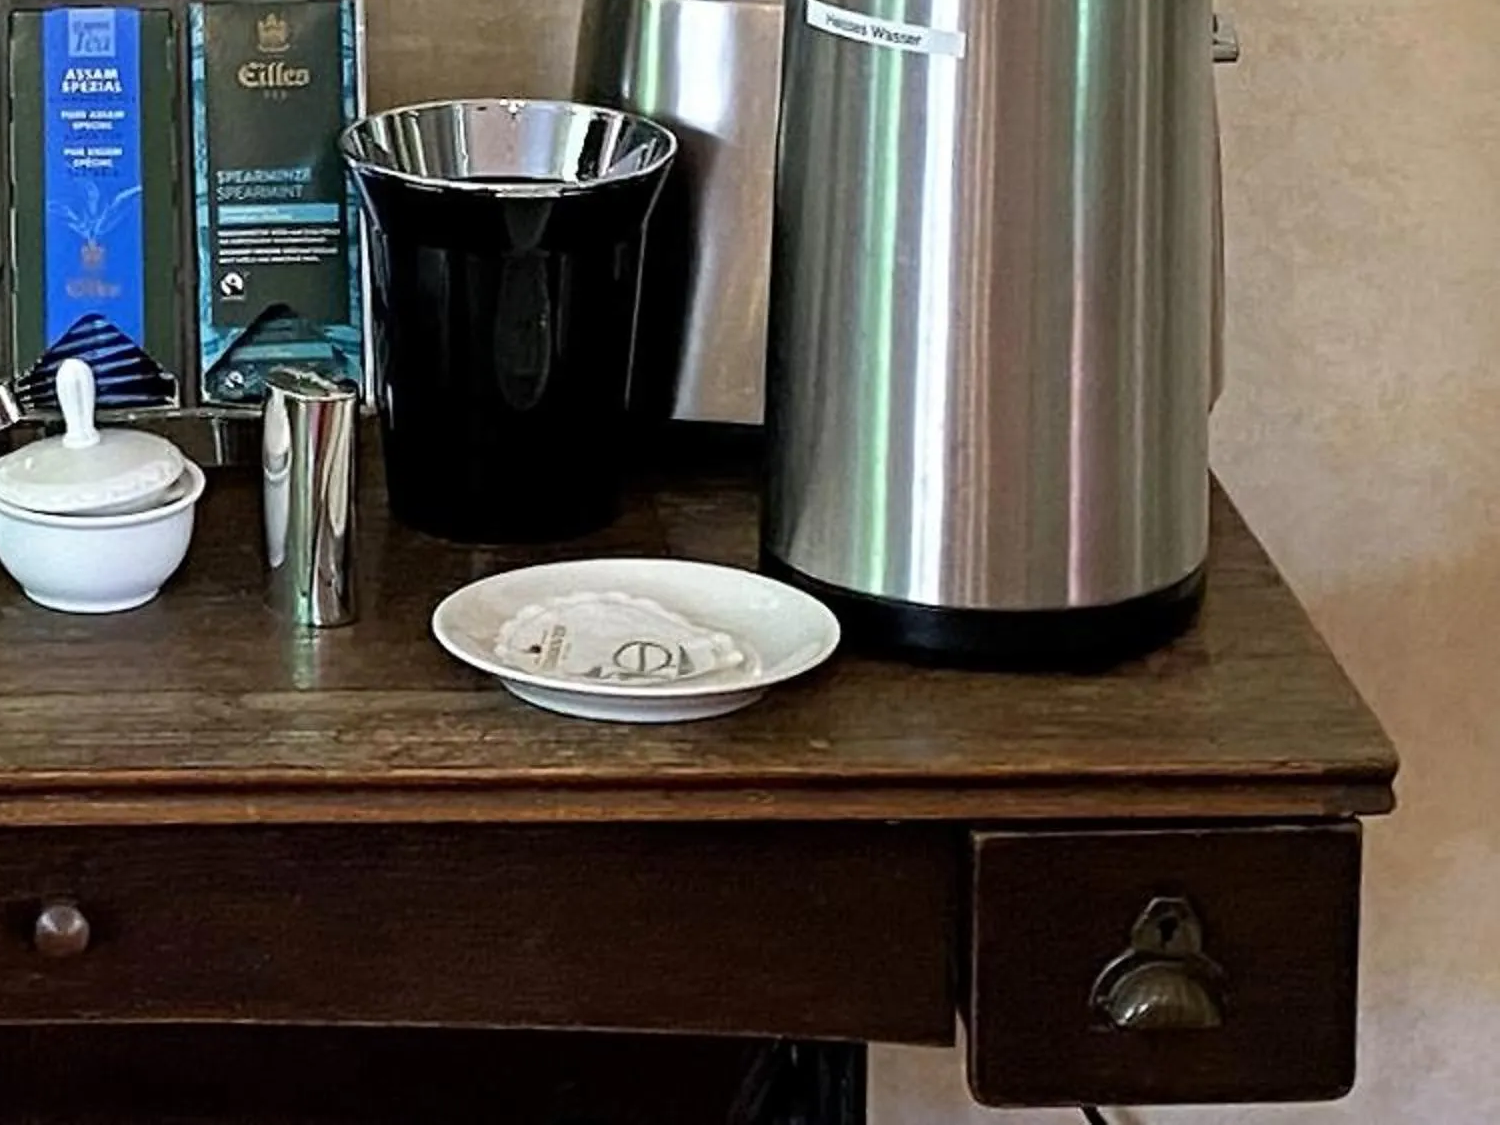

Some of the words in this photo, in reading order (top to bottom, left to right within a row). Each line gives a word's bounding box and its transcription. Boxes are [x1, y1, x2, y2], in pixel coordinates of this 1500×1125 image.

[871, 25, 923, 46] Wasser
[65, 68, 119, 79] ASSAM
[237, 62, 311, 88] Eilles
[61, 80, 122, 93] SPEZIAL
